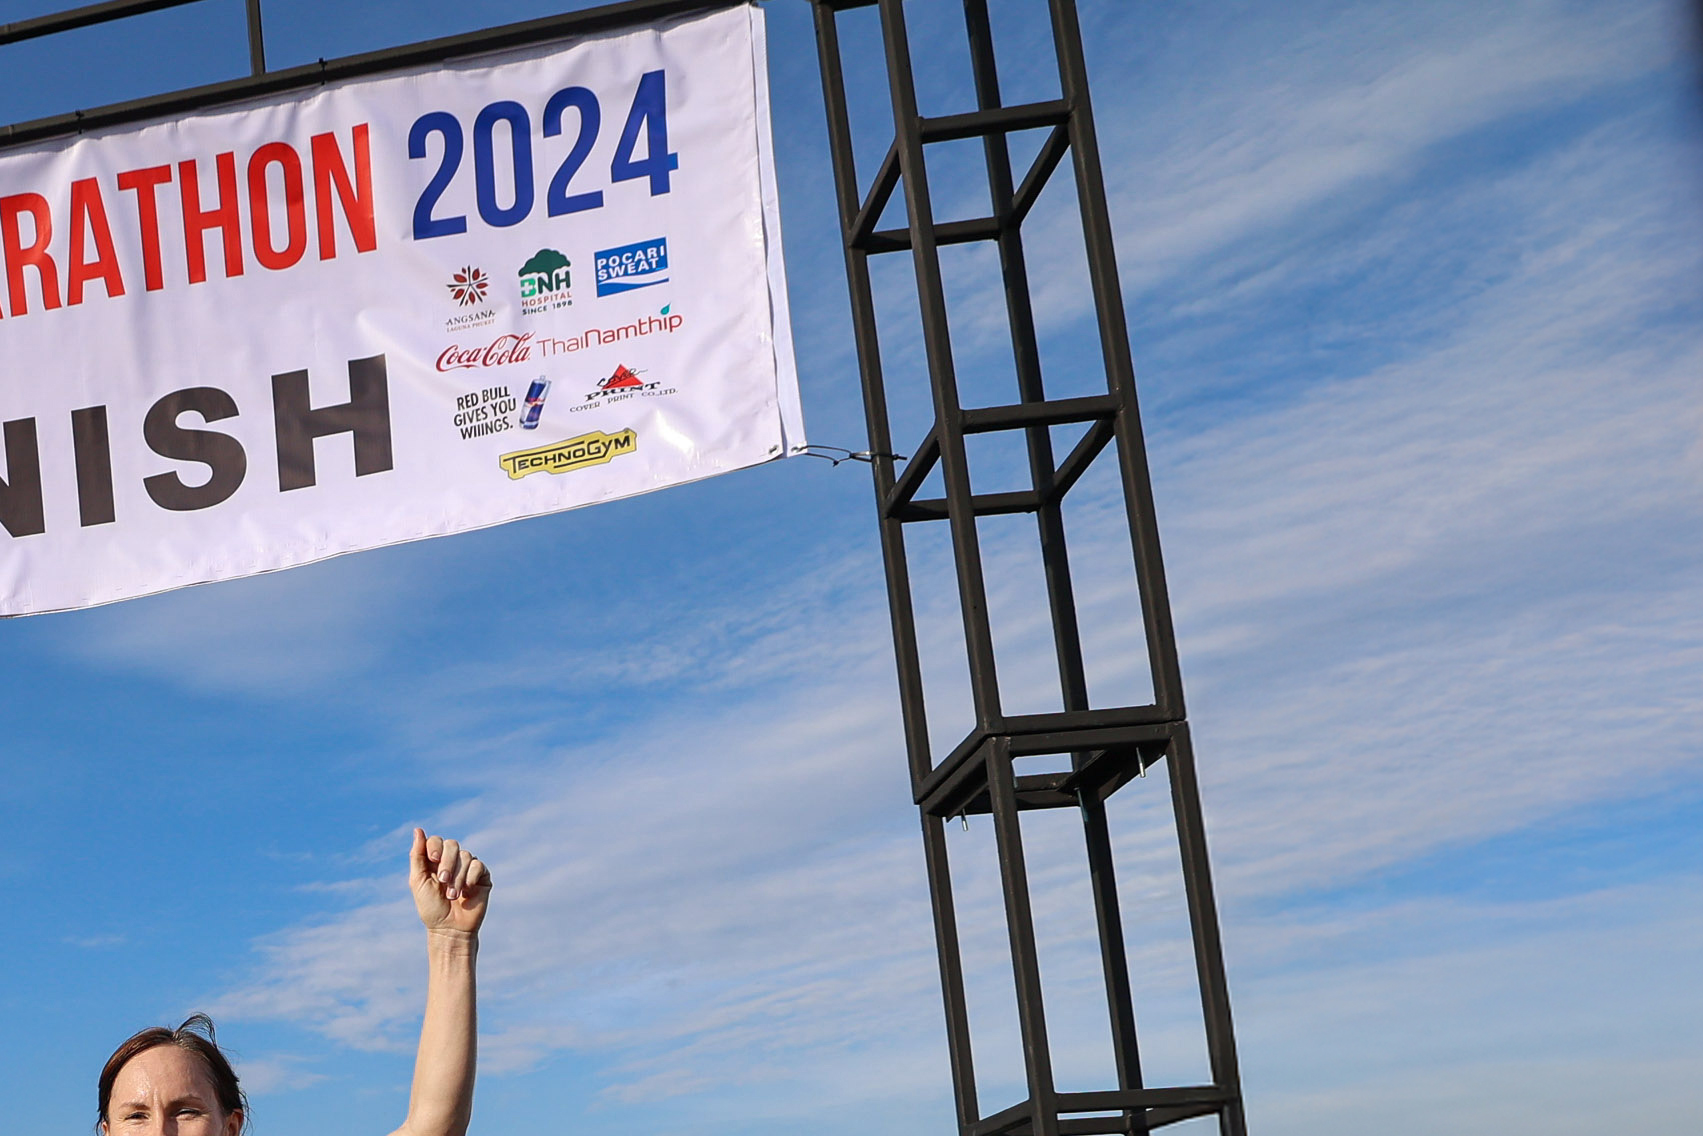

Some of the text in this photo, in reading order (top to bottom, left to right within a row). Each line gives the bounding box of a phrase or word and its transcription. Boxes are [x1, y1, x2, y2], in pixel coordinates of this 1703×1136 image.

[408, 69, 679, 240] 2024
[597, 245, 665, 270] POCARI
[598, 258, 660, 281] SWEAT
[520, 270, 572, 298] BNH
[522, 291, 573, 307] HOSPITAL
[522, 300, 573, 316] SINCE 1898
[446, 309, 496, 326] ANGSANA
[446, 323, 471, 332] LAGUNA
[536, 306, 683, 357] ThaiNamthip
[457, 391, 478, 411] RED
[482, 386, 510, 405] BULL
[569, 401, 600, 412] COVER
[607, 393, 634, 405] PRINT
[584, 381, 661, 402] PRINT
[454, 406, 488, 427] GIVES
[490, 398, 517, 417] YOU
[460, 419, 514, 440] WIIINGS.
